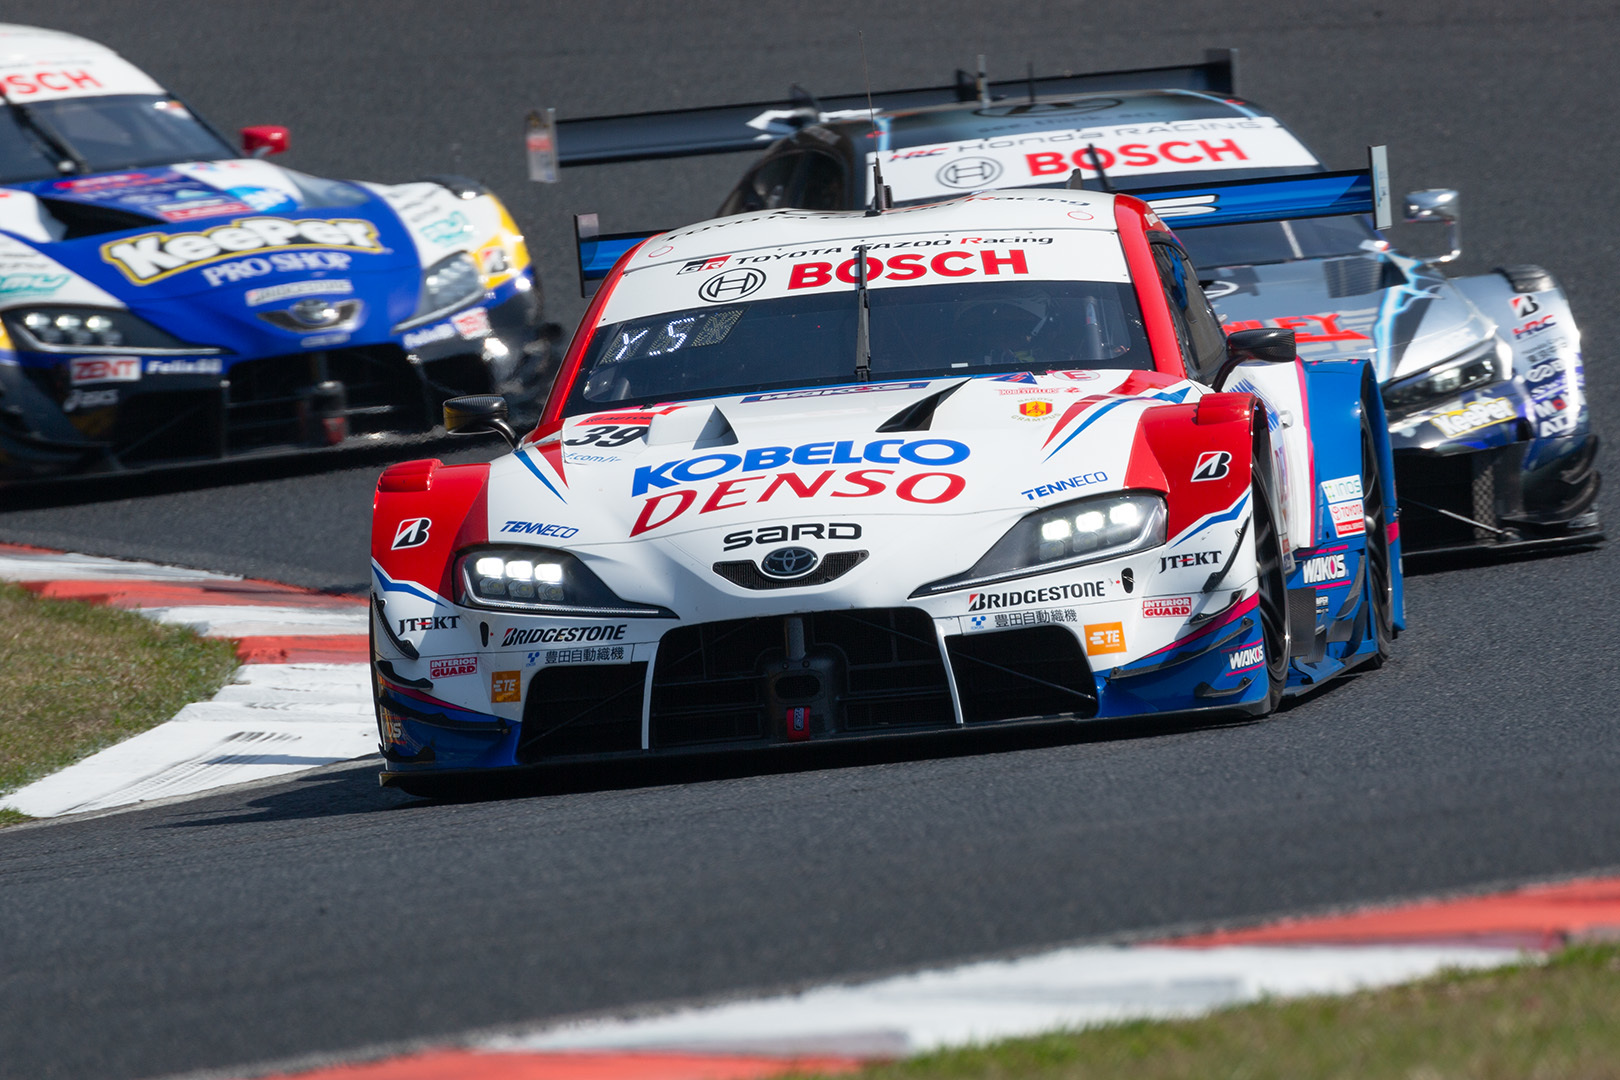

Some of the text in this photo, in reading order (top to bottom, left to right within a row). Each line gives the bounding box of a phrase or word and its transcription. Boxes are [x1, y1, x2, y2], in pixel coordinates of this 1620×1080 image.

[0, 69, 102, 95] SCH
[1025, 138, 1251, 176] BOSCH
[107, 218, 379, 281] KeePer
[735, 247, 842, 265] TOYOTA
[960, 236, 1054, 245] Racing
[202, 251, 352, 287] PRO SHOP
[787, 249, 1029, 290] BOSCH
[72, 359, 139, 380] ZENT
[1433, 400, 1513, 435] KeePer
[563, 425, 650, 448] 39
[631, 438, 971, 498] KOBELCO
[1020, 471, 1109, 501] TENNECO
[629, 469, 967, 539] DENSO
[1340, 503, 1363, 517] TOYOTA
[499, 520, 579, 539] TENNECO
[1158, 550, 1222, 574] JTEKT
[968, 581, 1106, 612] BRIDGESTONE
[1143, 597, 1190, 608] INTERIOR
[1144, 606, 1191, 617] GUARD
[398, 615, 461, 636] JTEKT
[501, 624, 628, 648] BRIDGESTONE
[1105, 629, 1120, 643] TE
[431, 657, 477, 668] INTERIOR
[431, 665, 477, 678] GUARD
